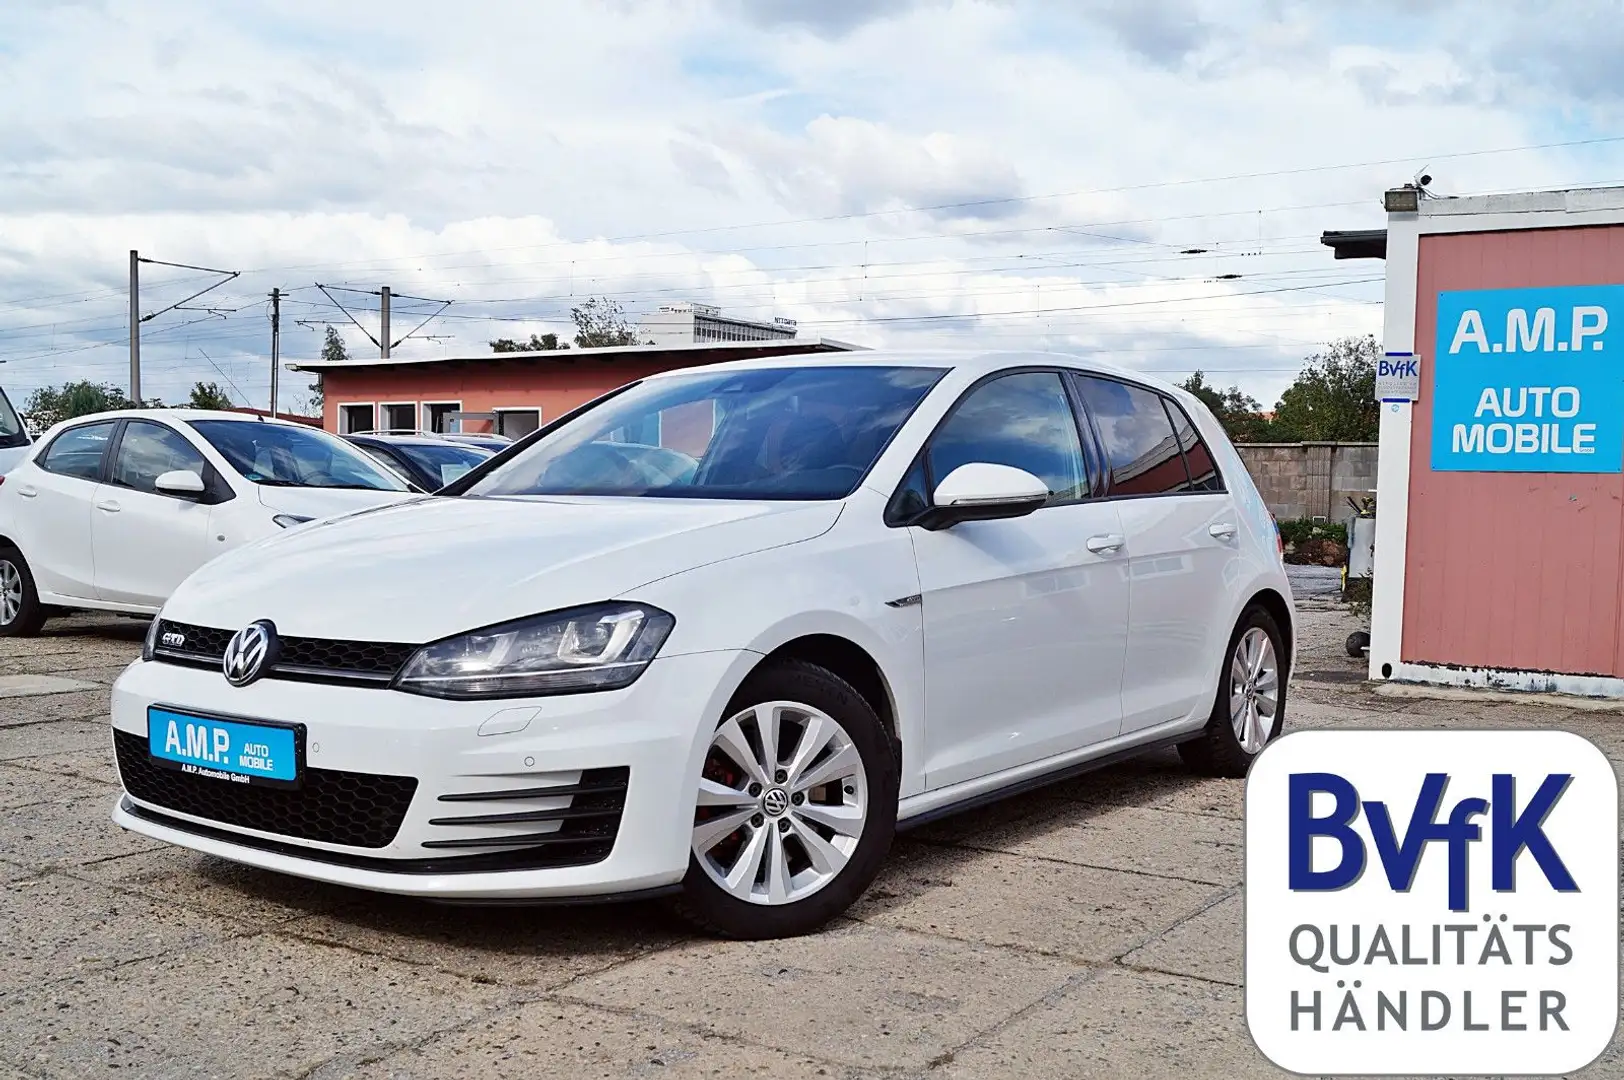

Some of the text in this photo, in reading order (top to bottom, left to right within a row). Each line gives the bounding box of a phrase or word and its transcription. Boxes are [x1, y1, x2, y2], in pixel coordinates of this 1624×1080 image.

[1448, 305, 1609, 354] A.M.P.
[1474, 386, 1581, 418] AUTO
[1452, 423, 1597, 454] MOBILE
[162, 632, 185, 646] GTD
[164, 719, 230, 765] A.M.P.
[243, 742, 269, 758] AUTO
[181, 763, 250, 784] A.M.P. Automobile GmbH
[239, 755, 274, 772] MOBILE
